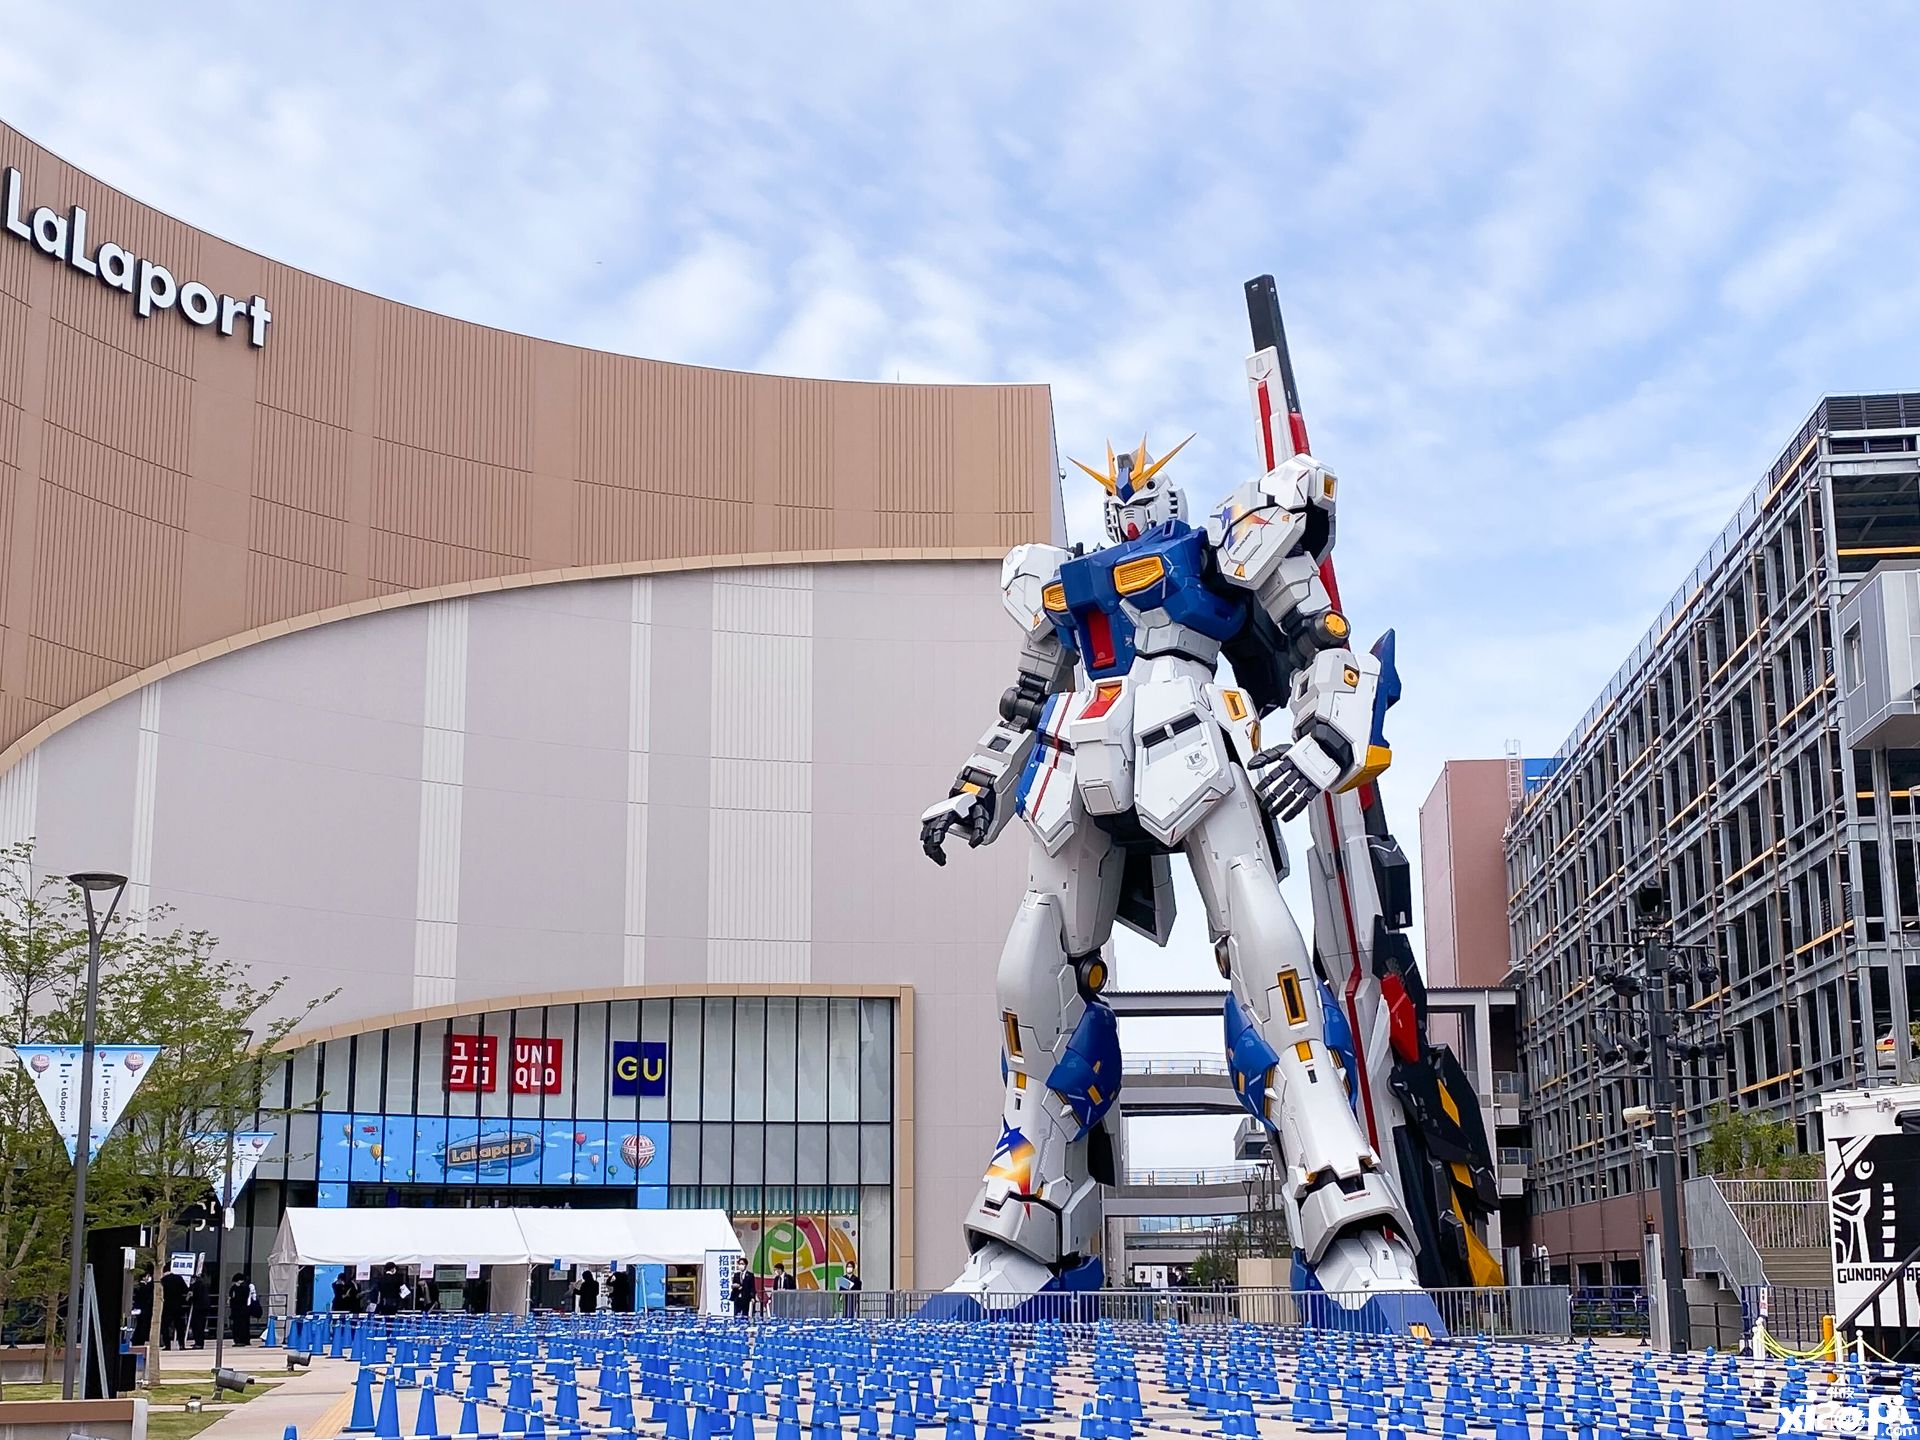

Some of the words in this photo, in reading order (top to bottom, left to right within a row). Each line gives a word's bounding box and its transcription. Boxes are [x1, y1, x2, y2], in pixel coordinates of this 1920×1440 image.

[5, 166, 272, 348] LaLaport
[516, 1044, 553, 1064] UNI
[515, 1067, 556, 1089] QLO
[617, 1056, 663, 1081] GU
[451, 1140, 528, 1163] LaLaport
[719, 1254, 730, 1313] 招待者受付
[1837, 1266, 1893, 1284] GUNDAM
